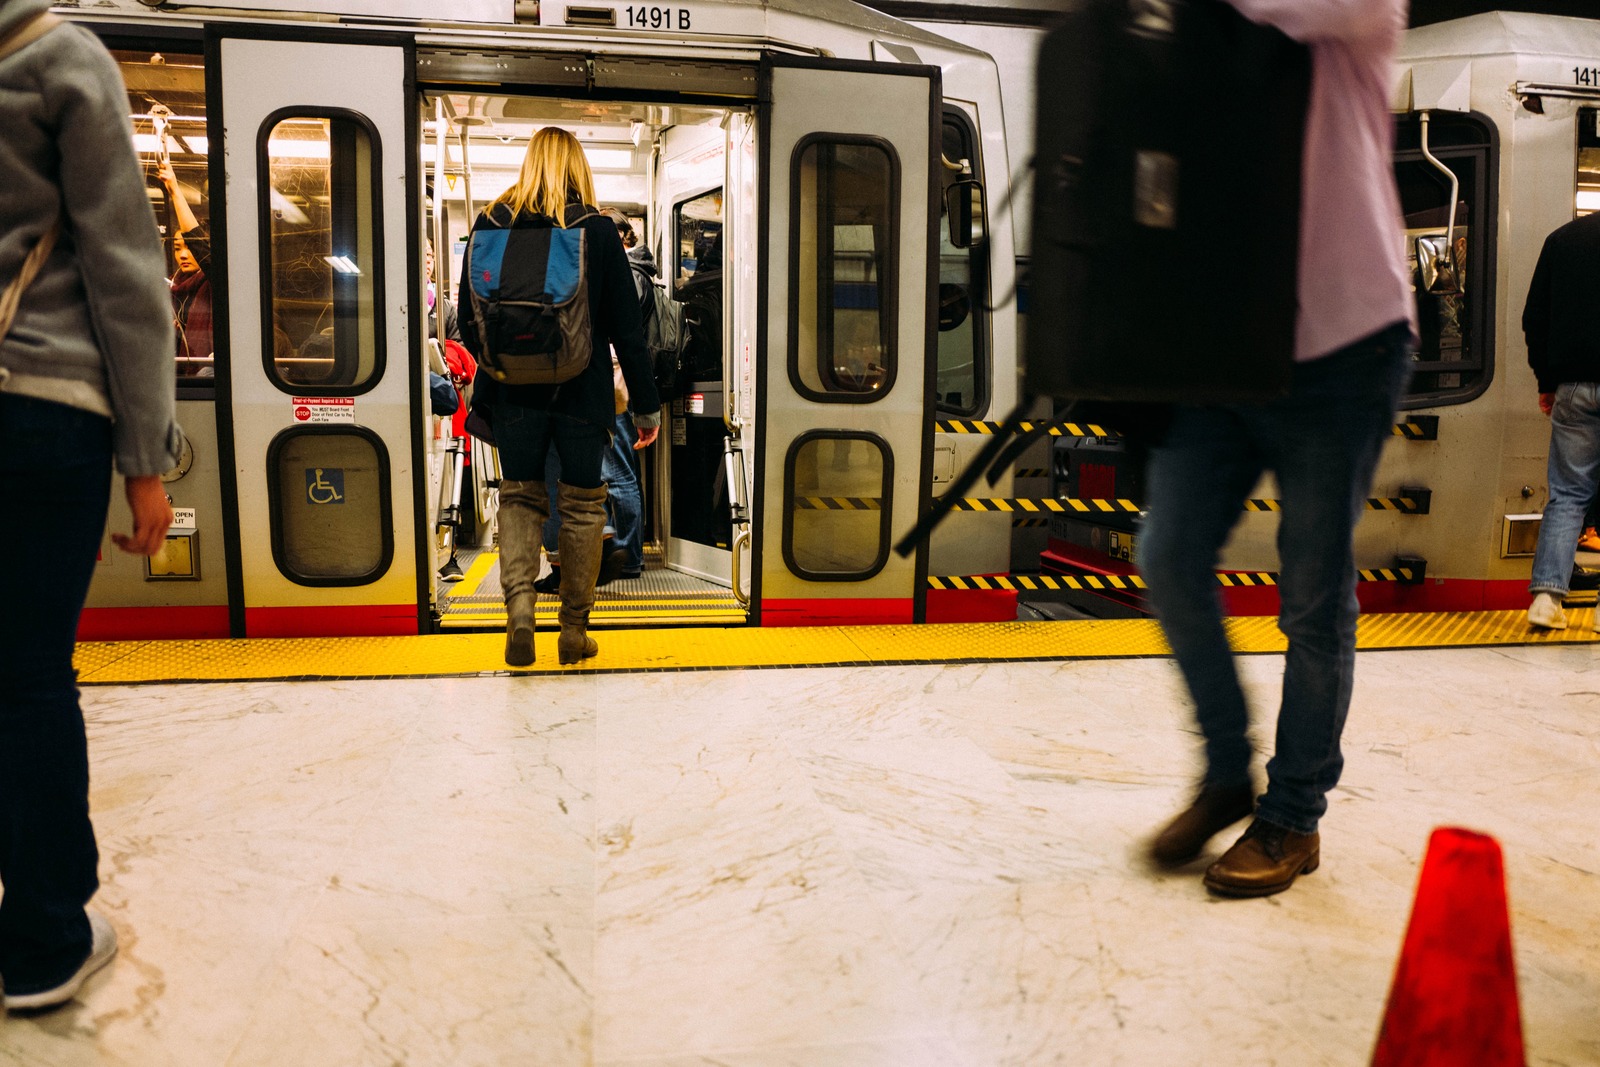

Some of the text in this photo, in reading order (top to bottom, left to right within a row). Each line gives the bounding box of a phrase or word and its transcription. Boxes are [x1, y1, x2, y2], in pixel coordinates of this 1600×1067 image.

[626, 6, 690, 29] 1491 B
[1573, 66, 1600, 86] 141
